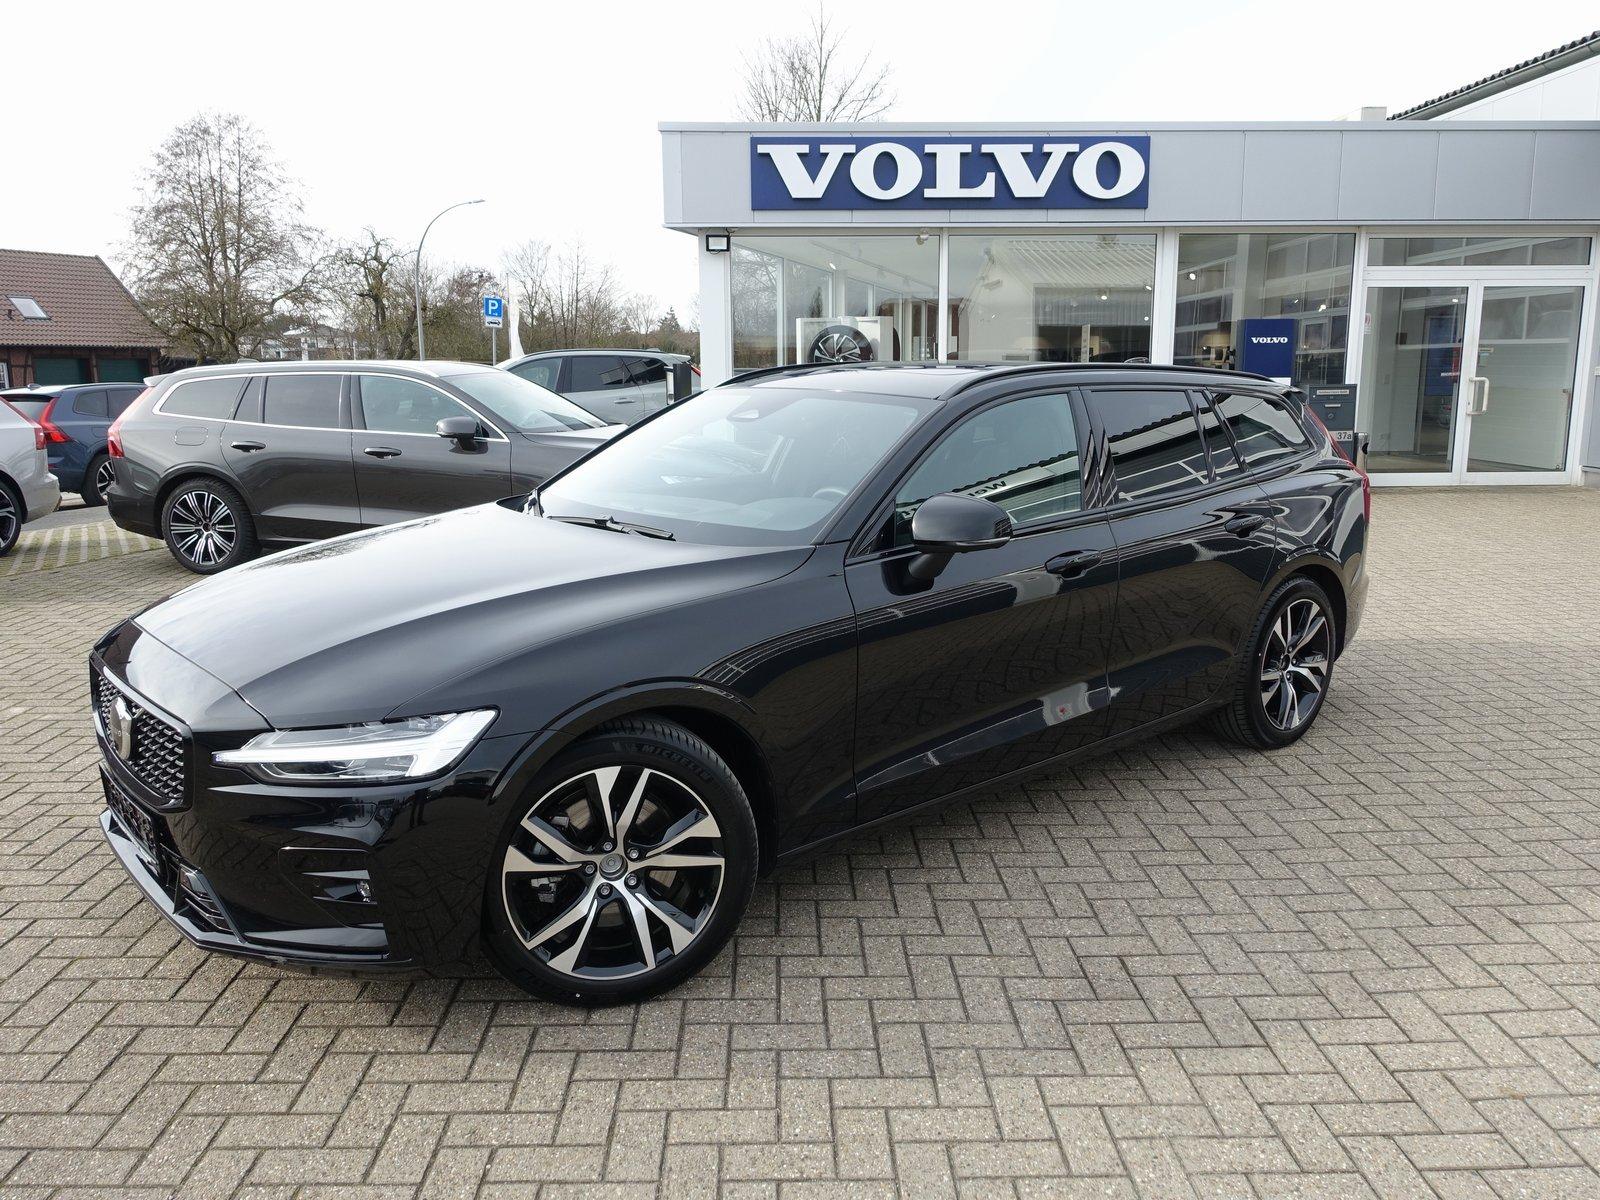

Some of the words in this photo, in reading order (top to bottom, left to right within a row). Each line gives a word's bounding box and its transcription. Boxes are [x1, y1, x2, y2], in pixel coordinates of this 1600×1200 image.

[756, 141, 1146, 201] VOLVO
[489, 299, 498, 314] P
[1251, 336, 1289, 344] VOLVO
[1337, 431, 1352, 440] 37a
